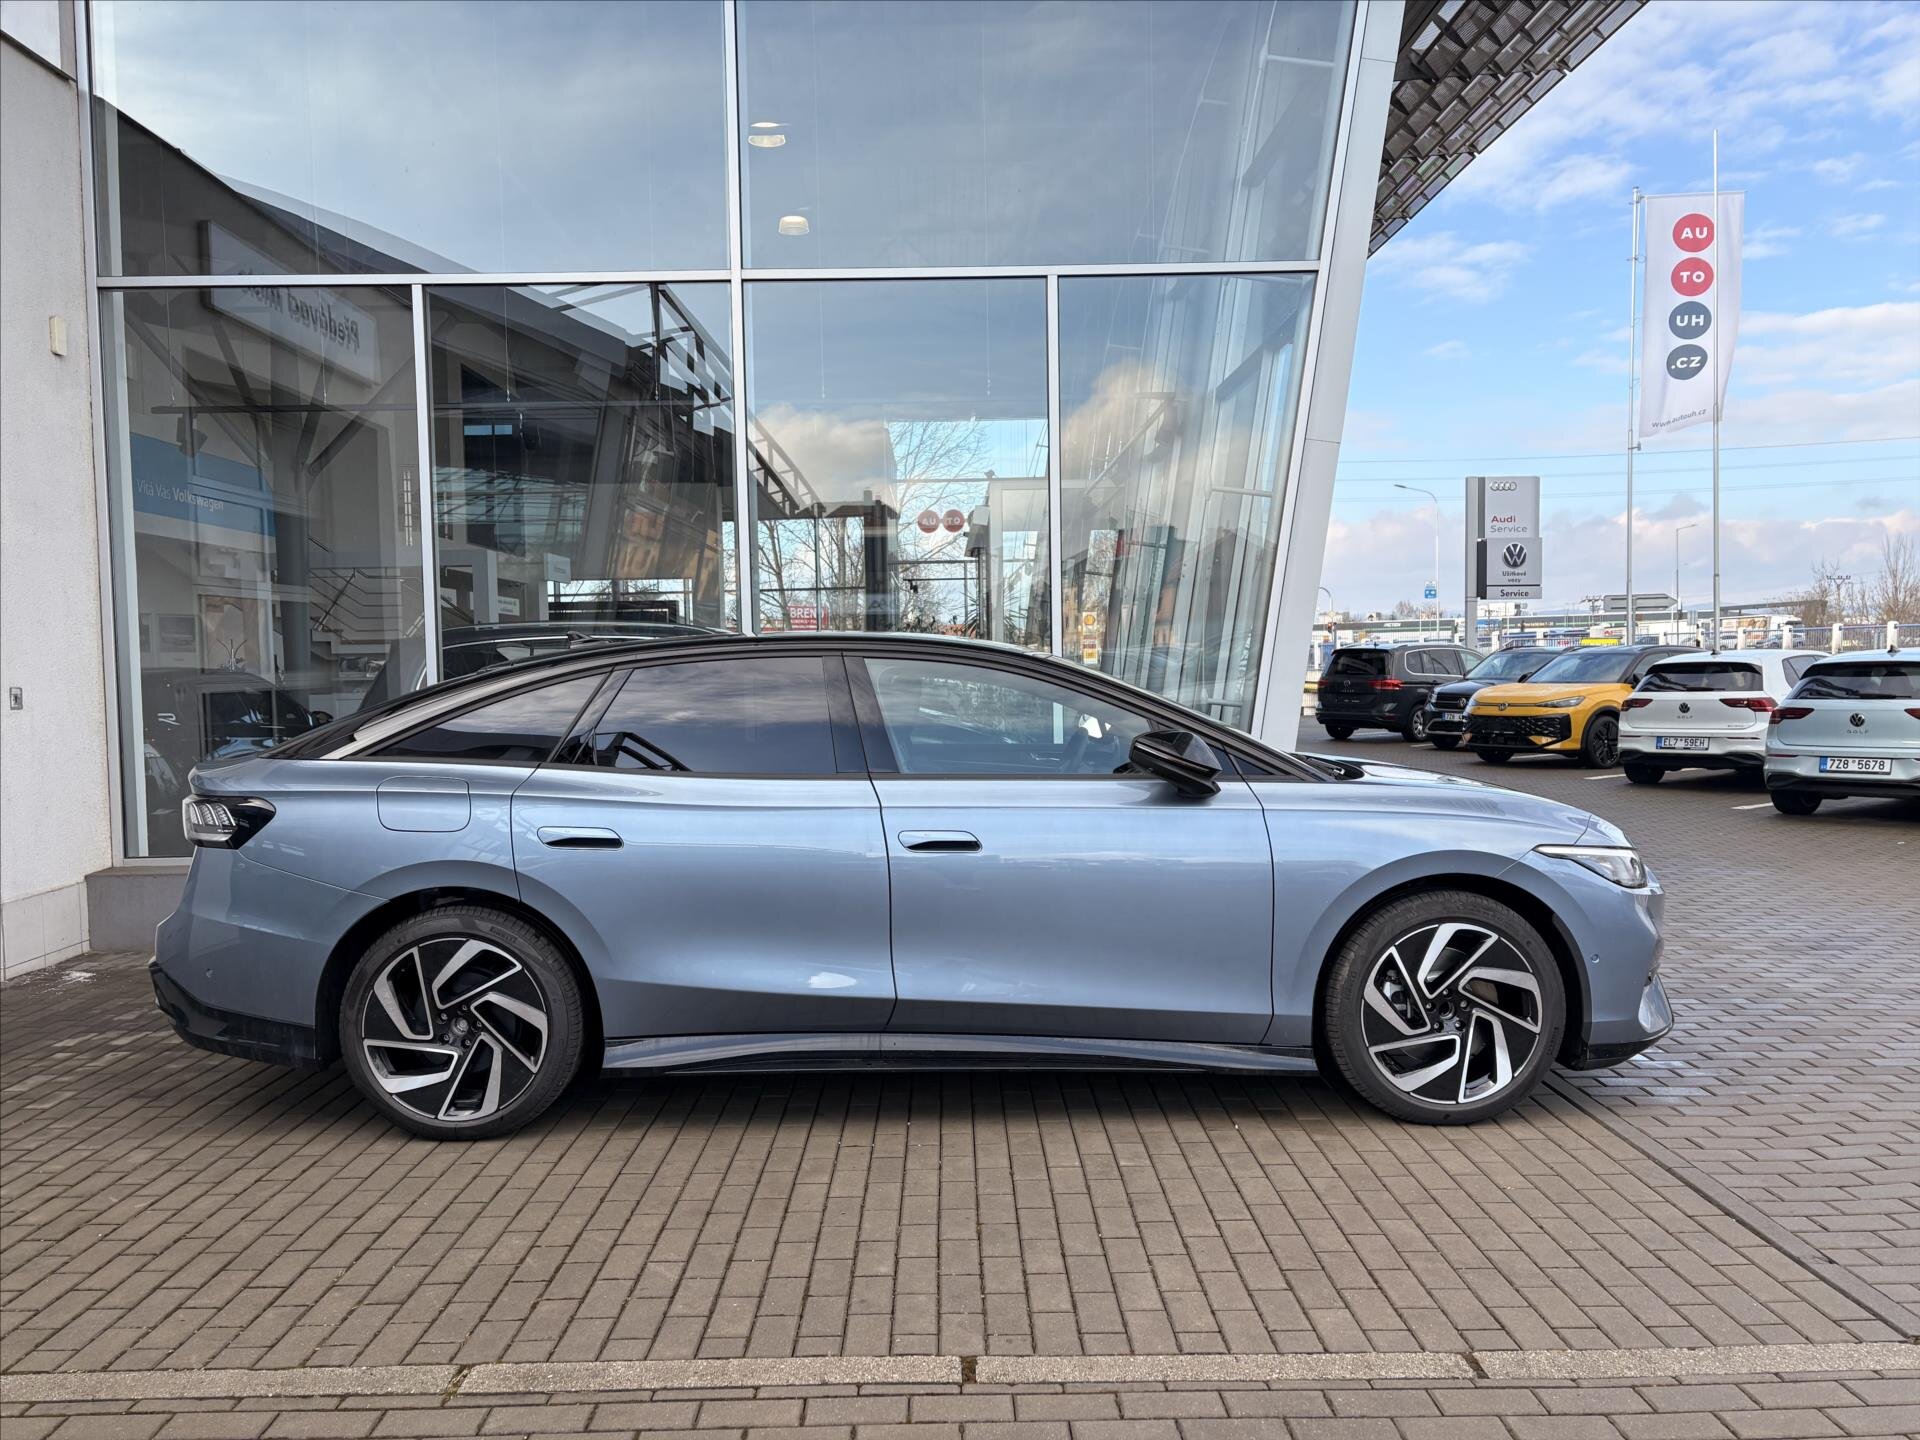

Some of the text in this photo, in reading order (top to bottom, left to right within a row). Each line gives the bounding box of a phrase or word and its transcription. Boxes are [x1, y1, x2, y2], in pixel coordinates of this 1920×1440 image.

[1680, 226, 1708, 240] AU
[1680, 270, 1706, 284] TO
[1675, 314, 1705, 327] UH
[1670, 355, 1702, 370] .CZ
[171, 487, 224, 512] Volkswagen
[944, 516, 961, 526] TO
[1490, 515, 1517, 524] Audi
[1489, 524, 1529, 534] Service
[1499, 588, 1530, 598] Service
[789, 606, 825, 619] BREN
[1662, 737, 1706, 748] EL7 59EH
[1829, 758, 1886, 771] 7Z8 5678
